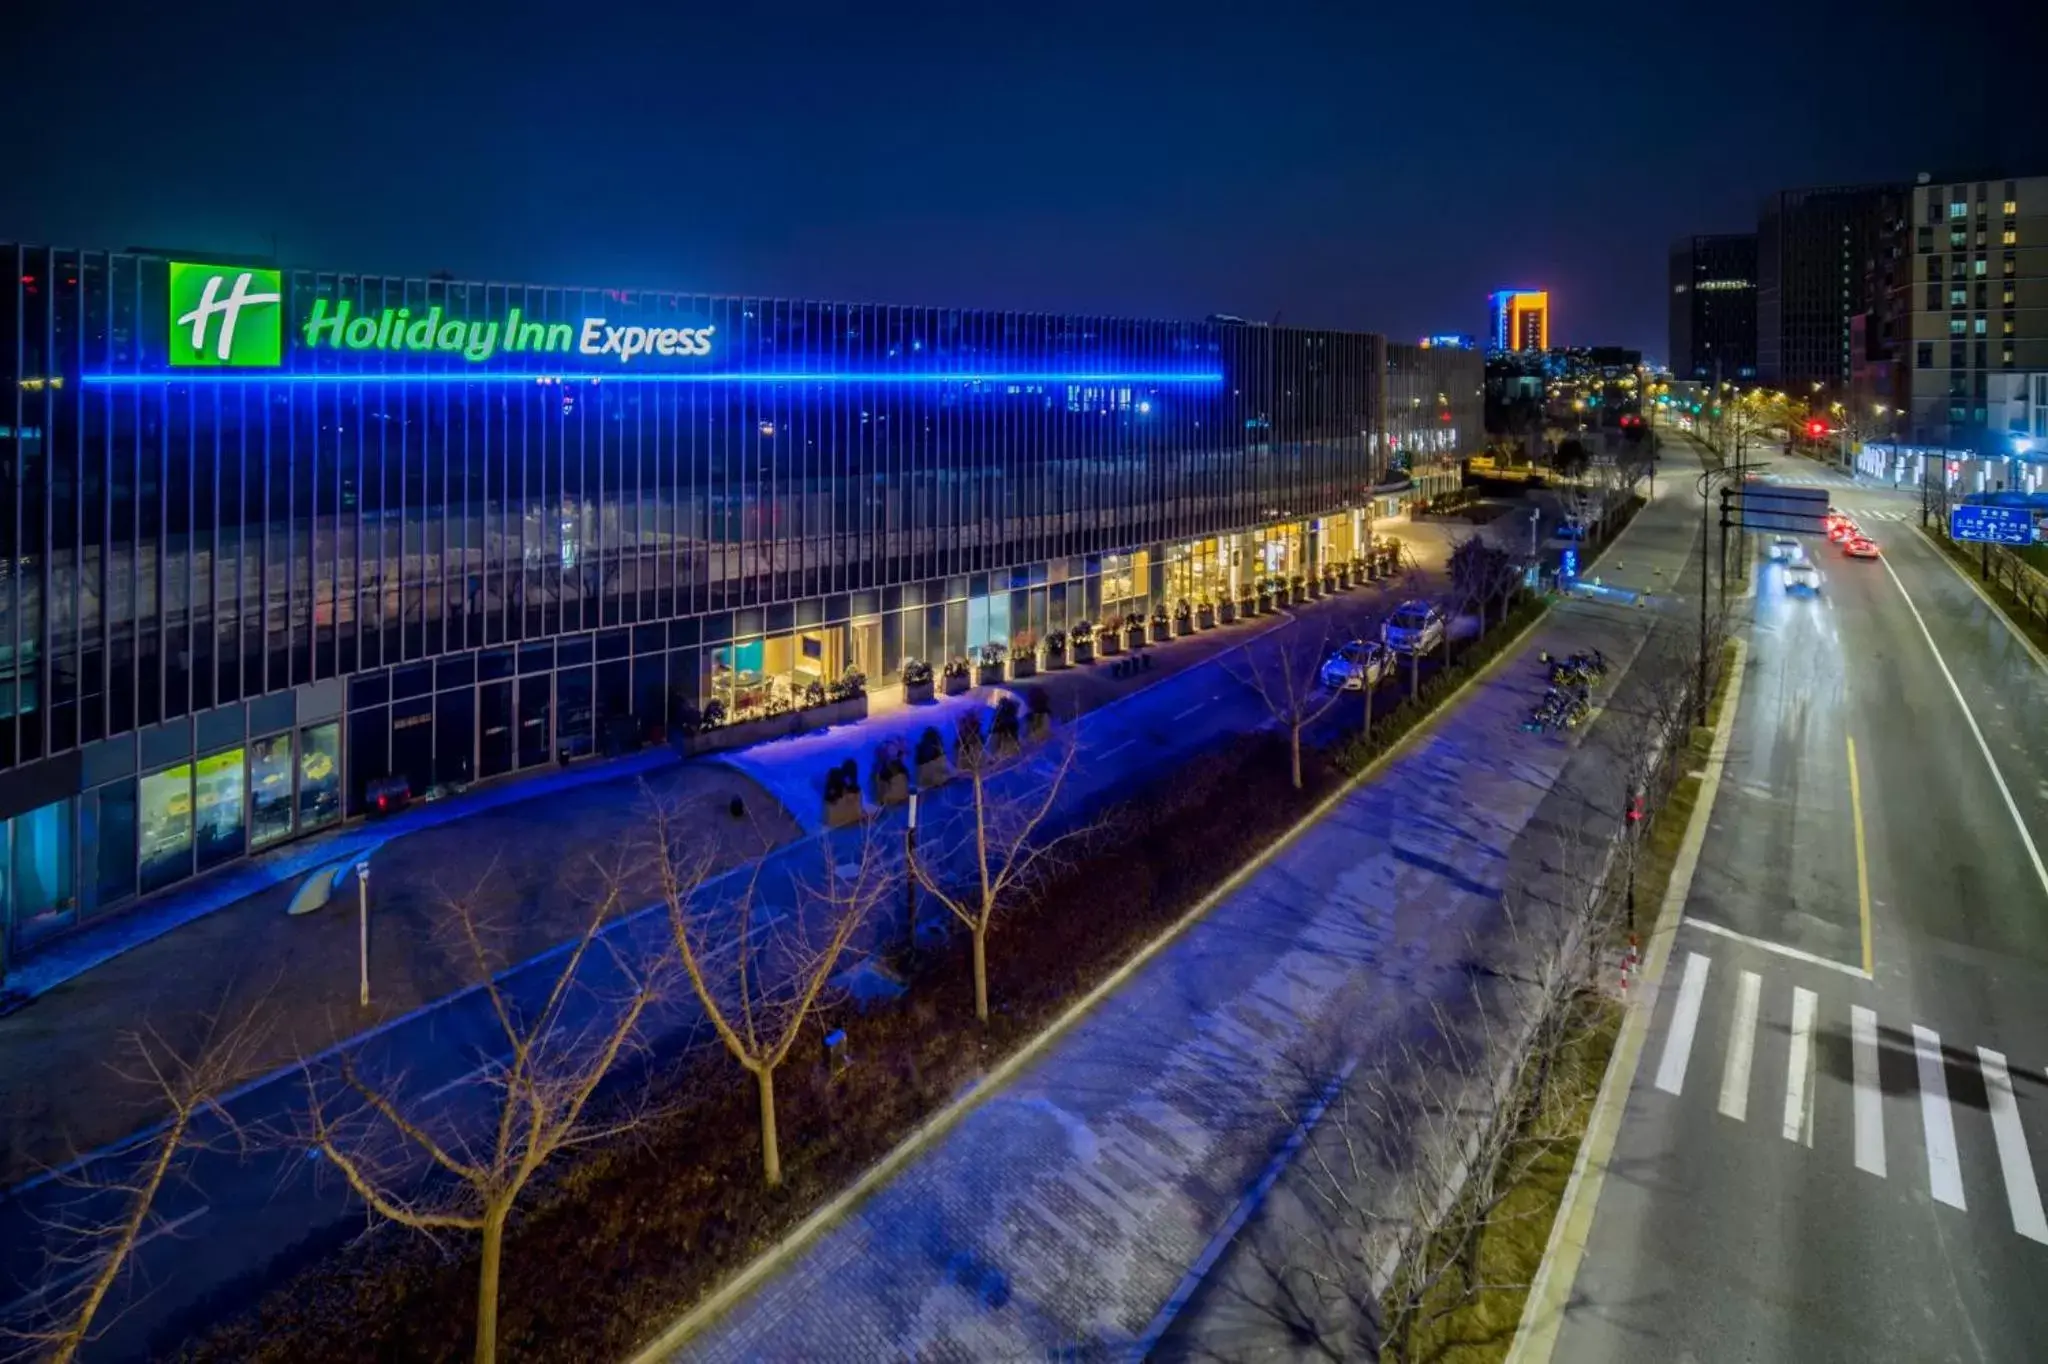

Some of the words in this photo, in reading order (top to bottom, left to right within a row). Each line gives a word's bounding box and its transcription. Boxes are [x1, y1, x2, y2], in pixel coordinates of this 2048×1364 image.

[303, 299, 499, 361] Holiday
[503, 308, 573, 352] Inn
[579, 317, 715, 363] Express
